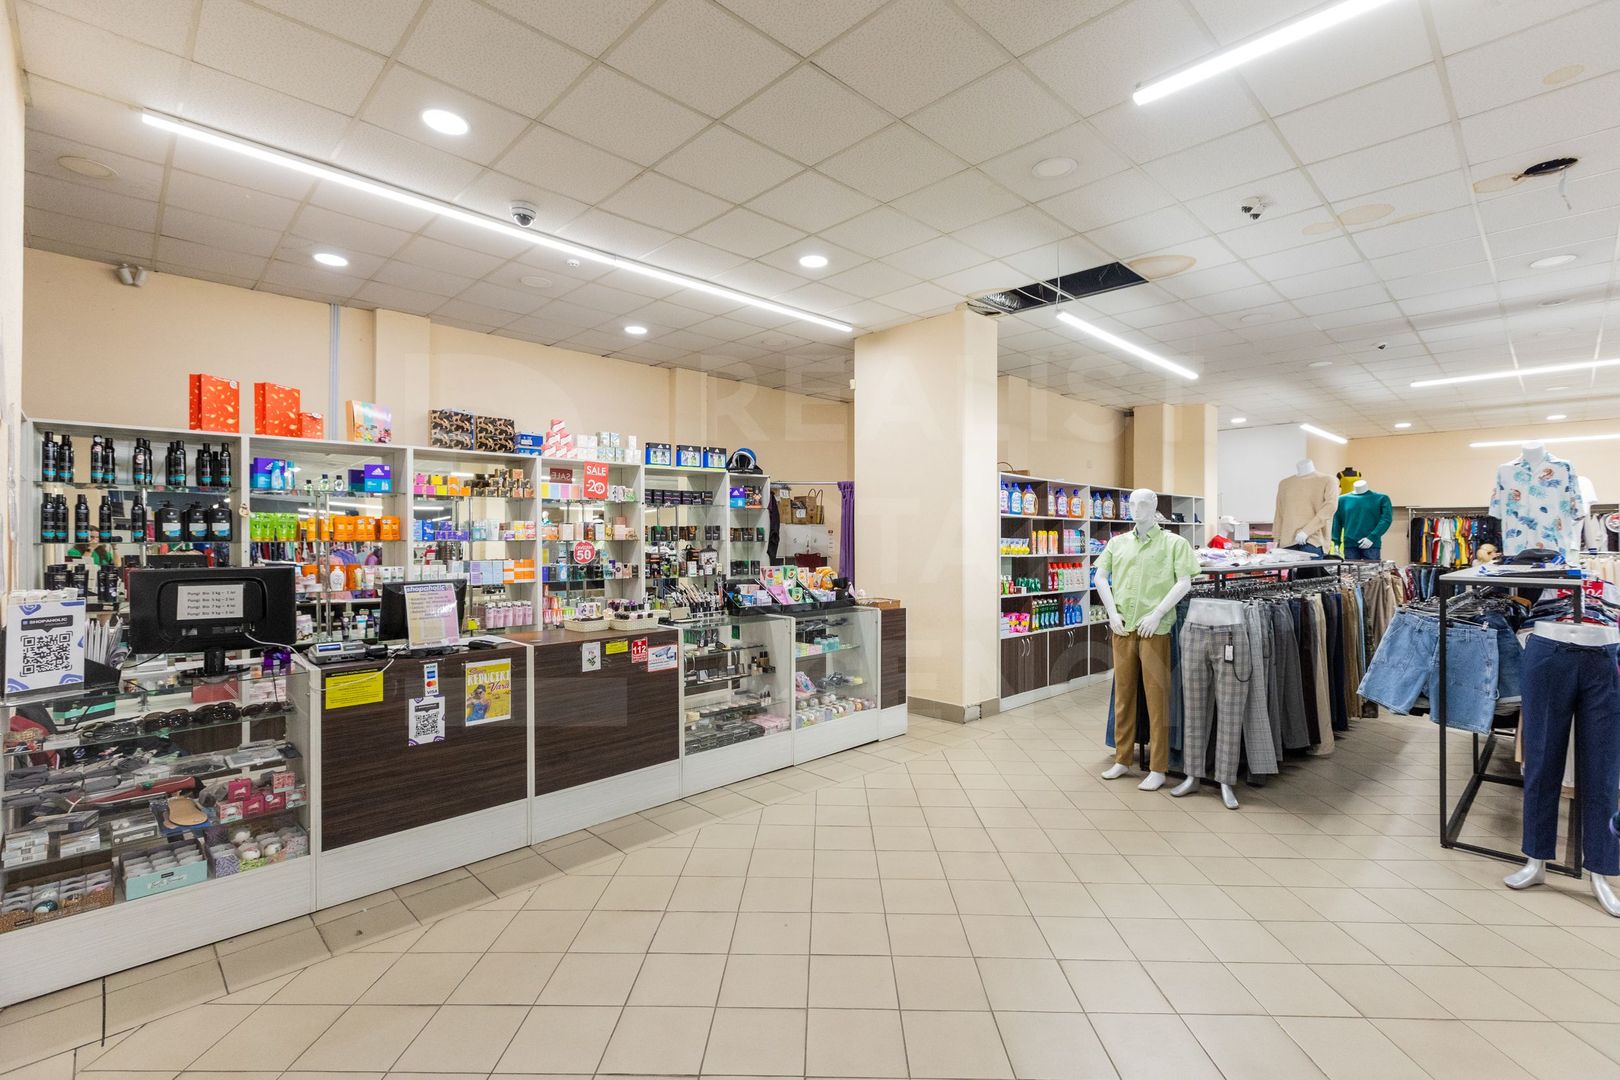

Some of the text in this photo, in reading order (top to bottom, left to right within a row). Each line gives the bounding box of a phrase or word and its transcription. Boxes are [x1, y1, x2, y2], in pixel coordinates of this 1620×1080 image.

[586, 465, 606, 476] SALE
[406, 585, 447, 593] shopaholic
[632, 645, 647, 655] 112
